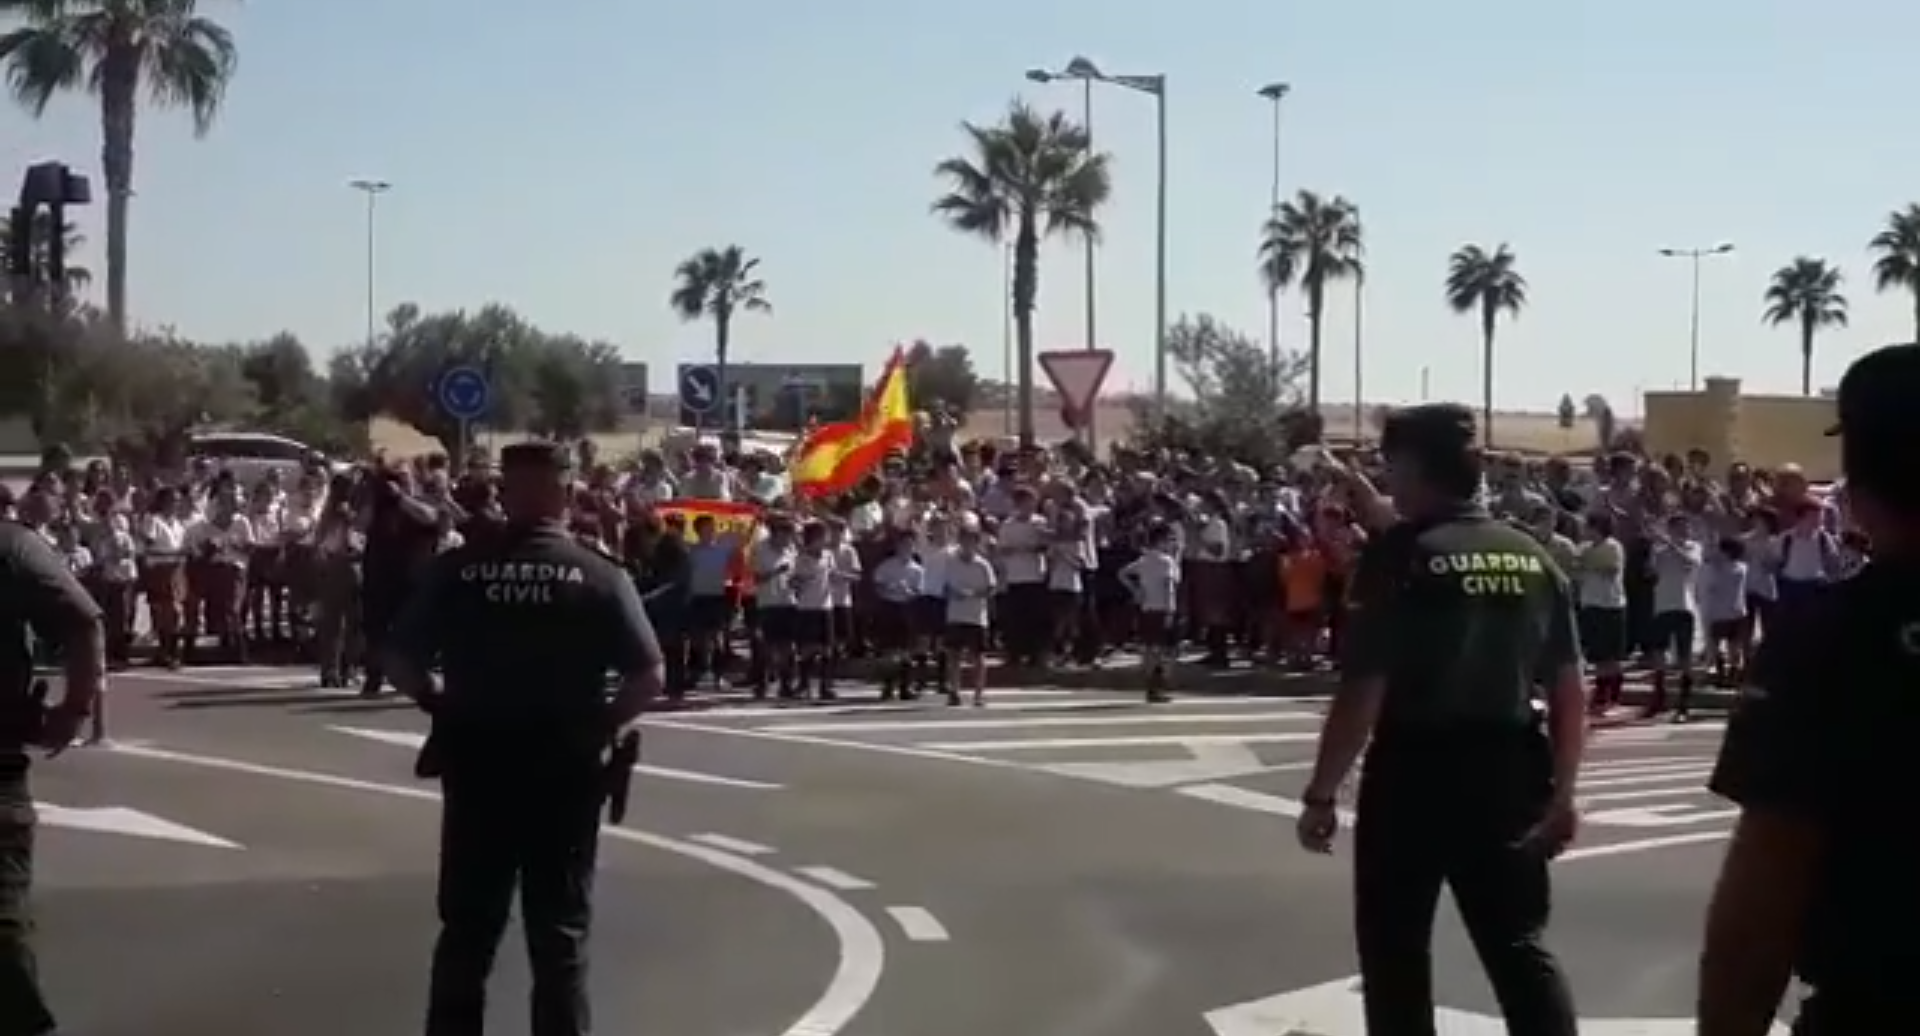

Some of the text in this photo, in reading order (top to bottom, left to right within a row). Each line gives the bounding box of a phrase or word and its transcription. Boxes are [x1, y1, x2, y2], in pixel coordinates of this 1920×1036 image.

[461, 563, 583, 583] GUARDIA
[1427, 552, 1542, 574] GUARDIA
[485, 583, 552, 602] CIVIL
[1463, 575, 1524, 595] CIVIL
